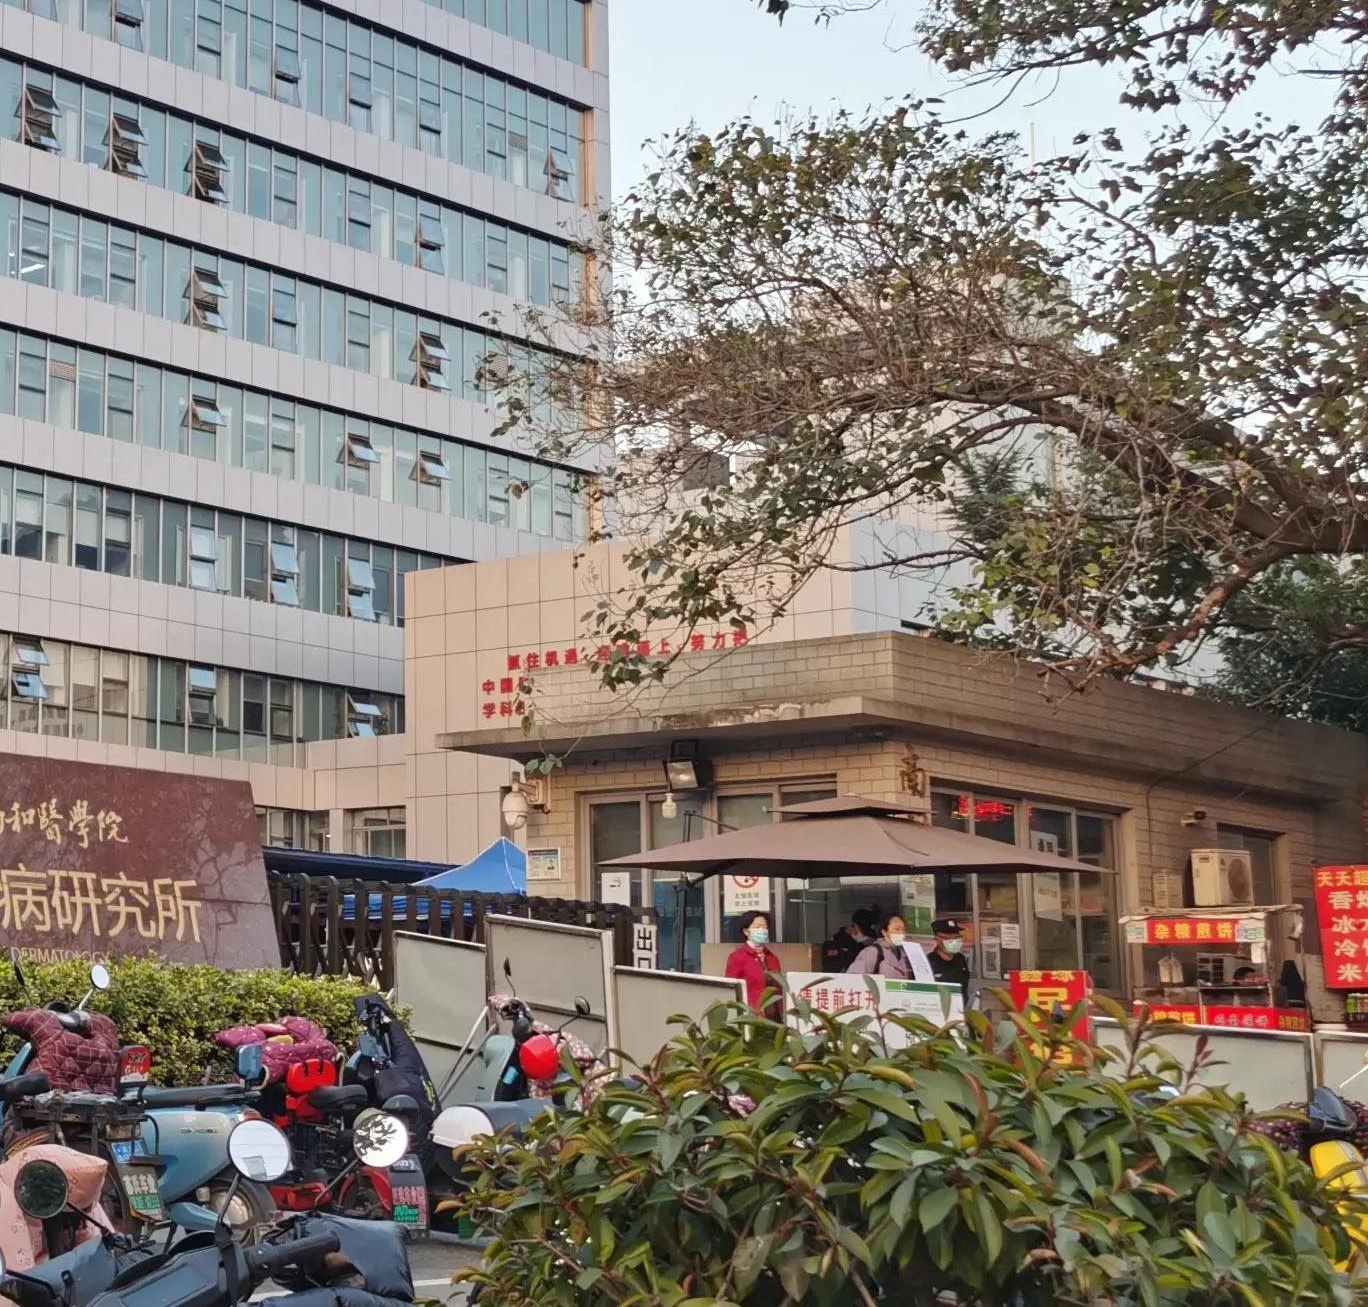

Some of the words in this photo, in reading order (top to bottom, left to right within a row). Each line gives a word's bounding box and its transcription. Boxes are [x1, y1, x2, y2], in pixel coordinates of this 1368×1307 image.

[1154, 921, 1233, 939] 杂粮煎饼
[11, 946, 109, 965] DERMATOLOGY
